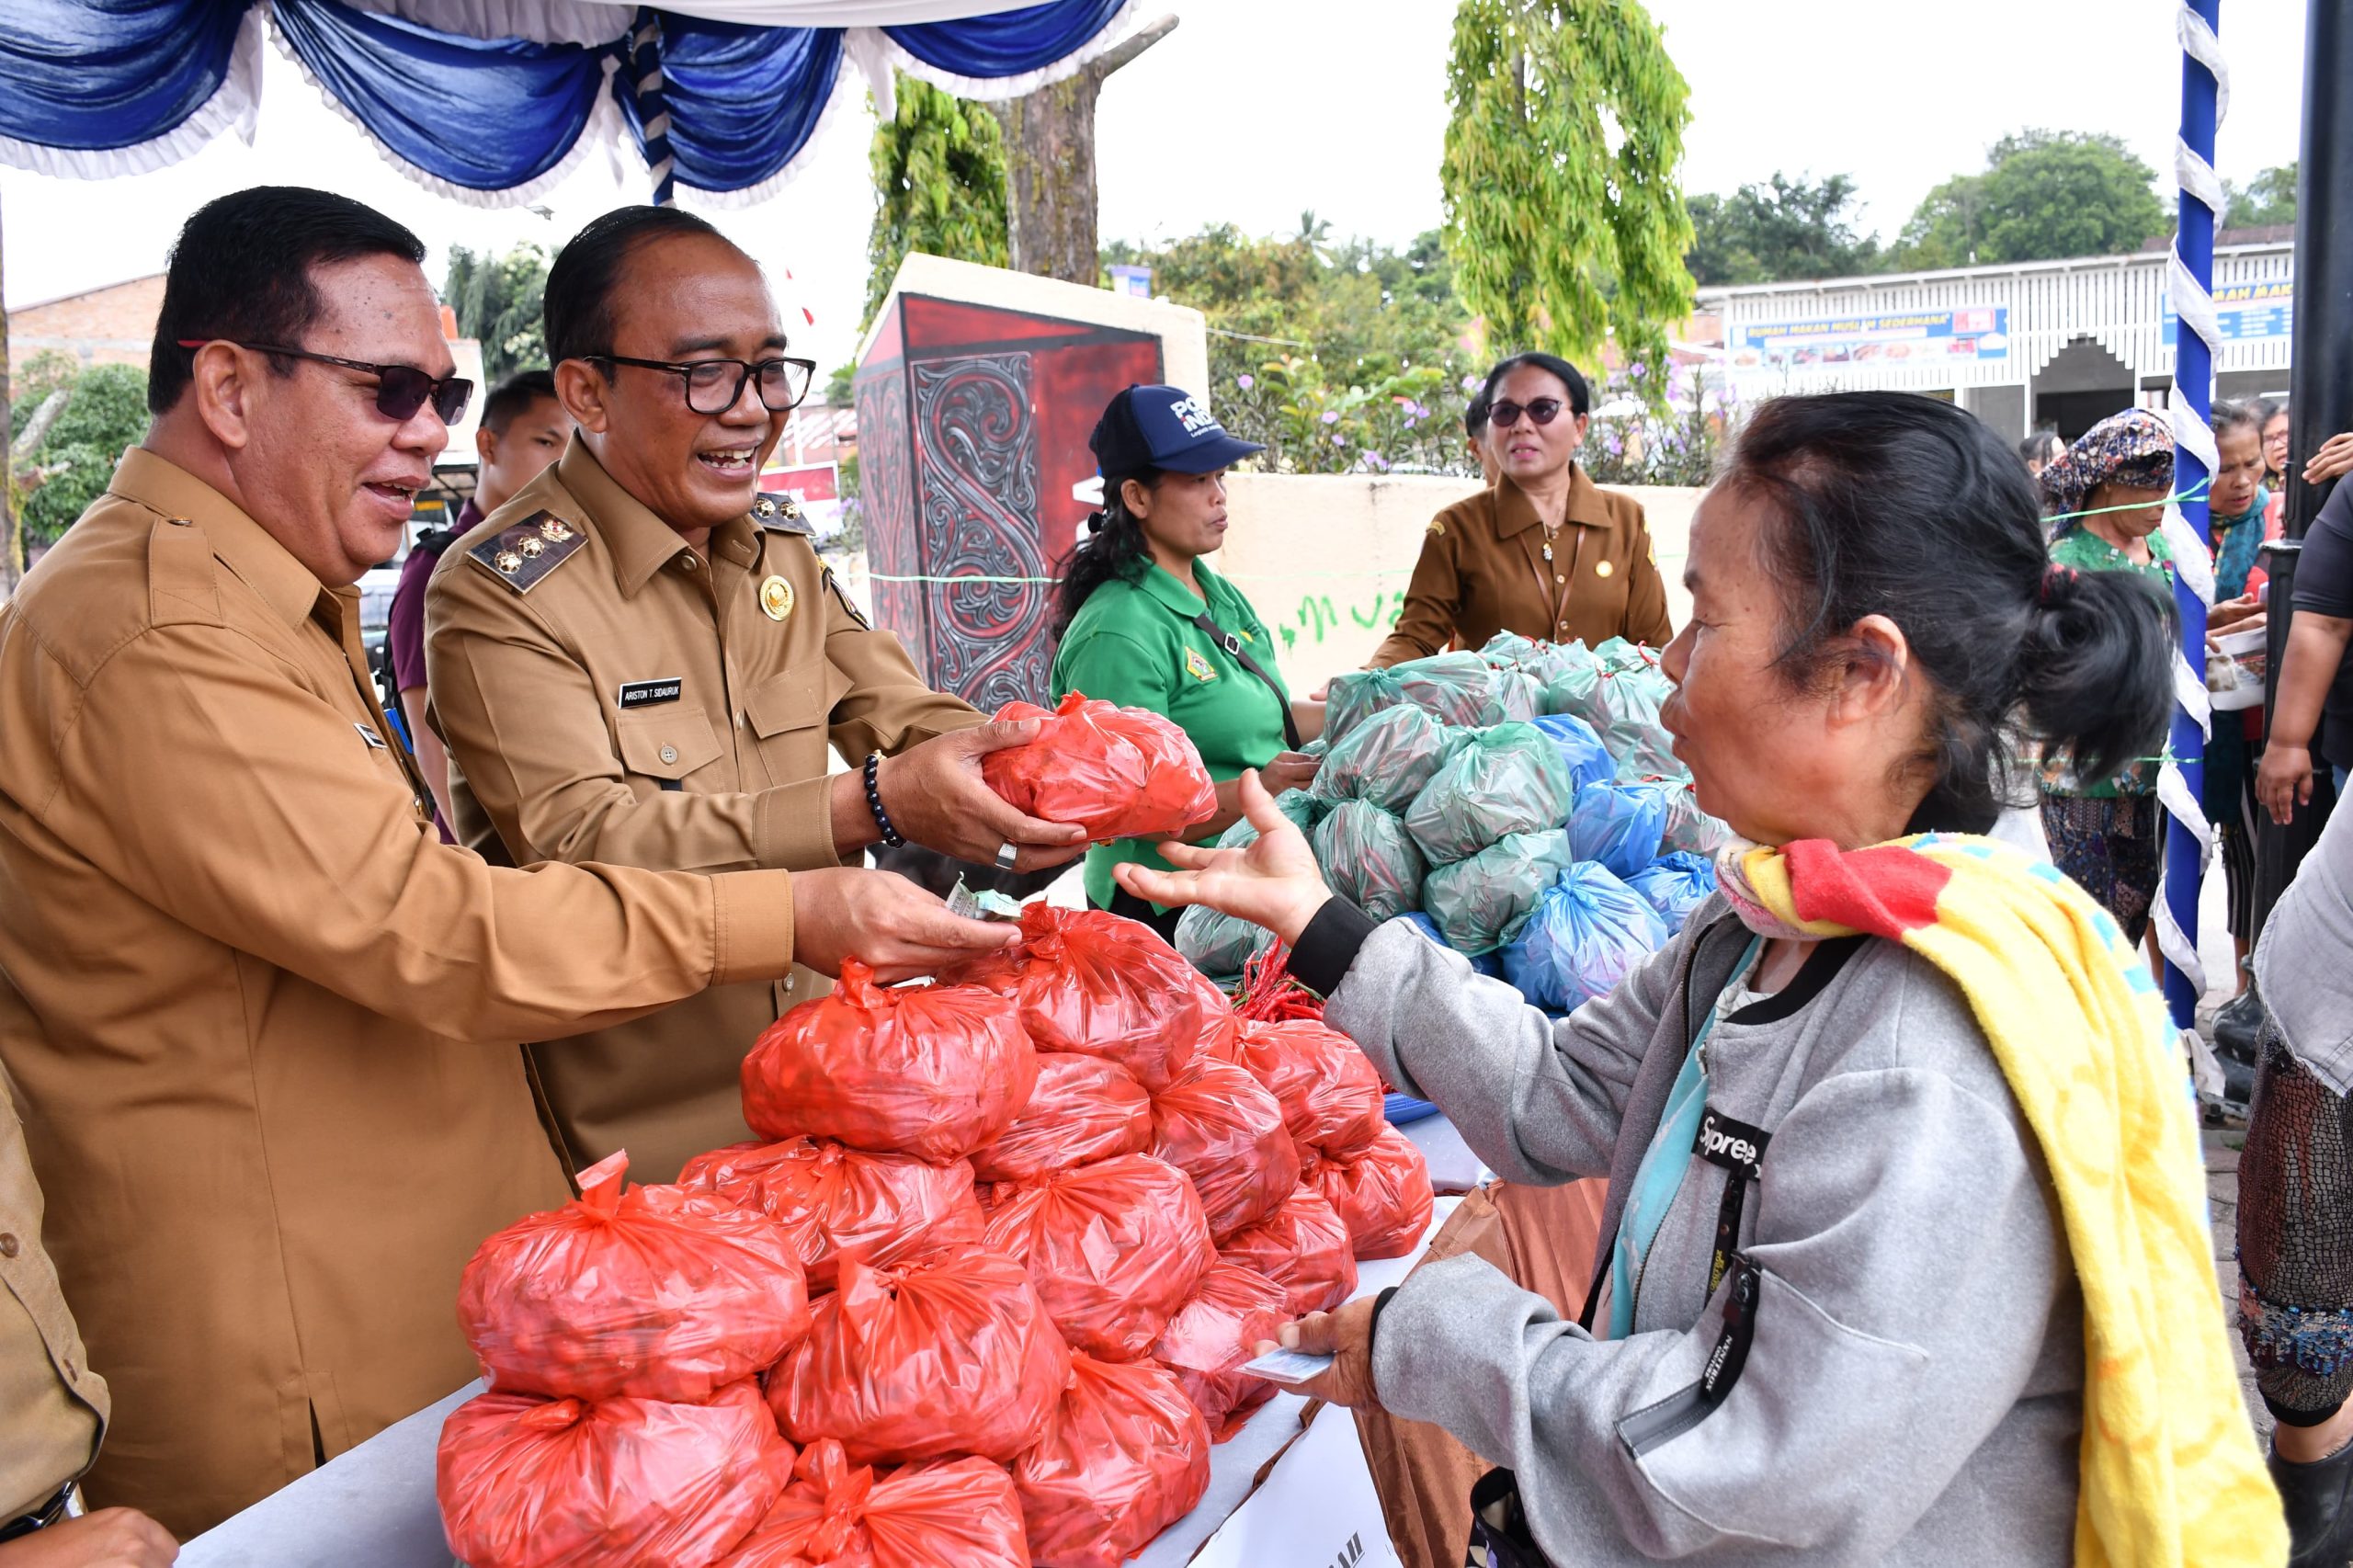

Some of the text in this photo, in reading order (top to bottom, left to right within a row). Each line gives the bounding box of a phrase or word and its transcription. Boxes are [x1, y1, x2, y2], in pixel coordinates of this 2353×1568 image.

[1748, 326, 1787, 337] RUMAH
[1790, 323, 1829, 335] MAKAN
[1832, 319, 1876, 333] MUSLM
[625, 689, 647, 700] ARISTON
[654, 686, 679, 698] SIDAURUK
